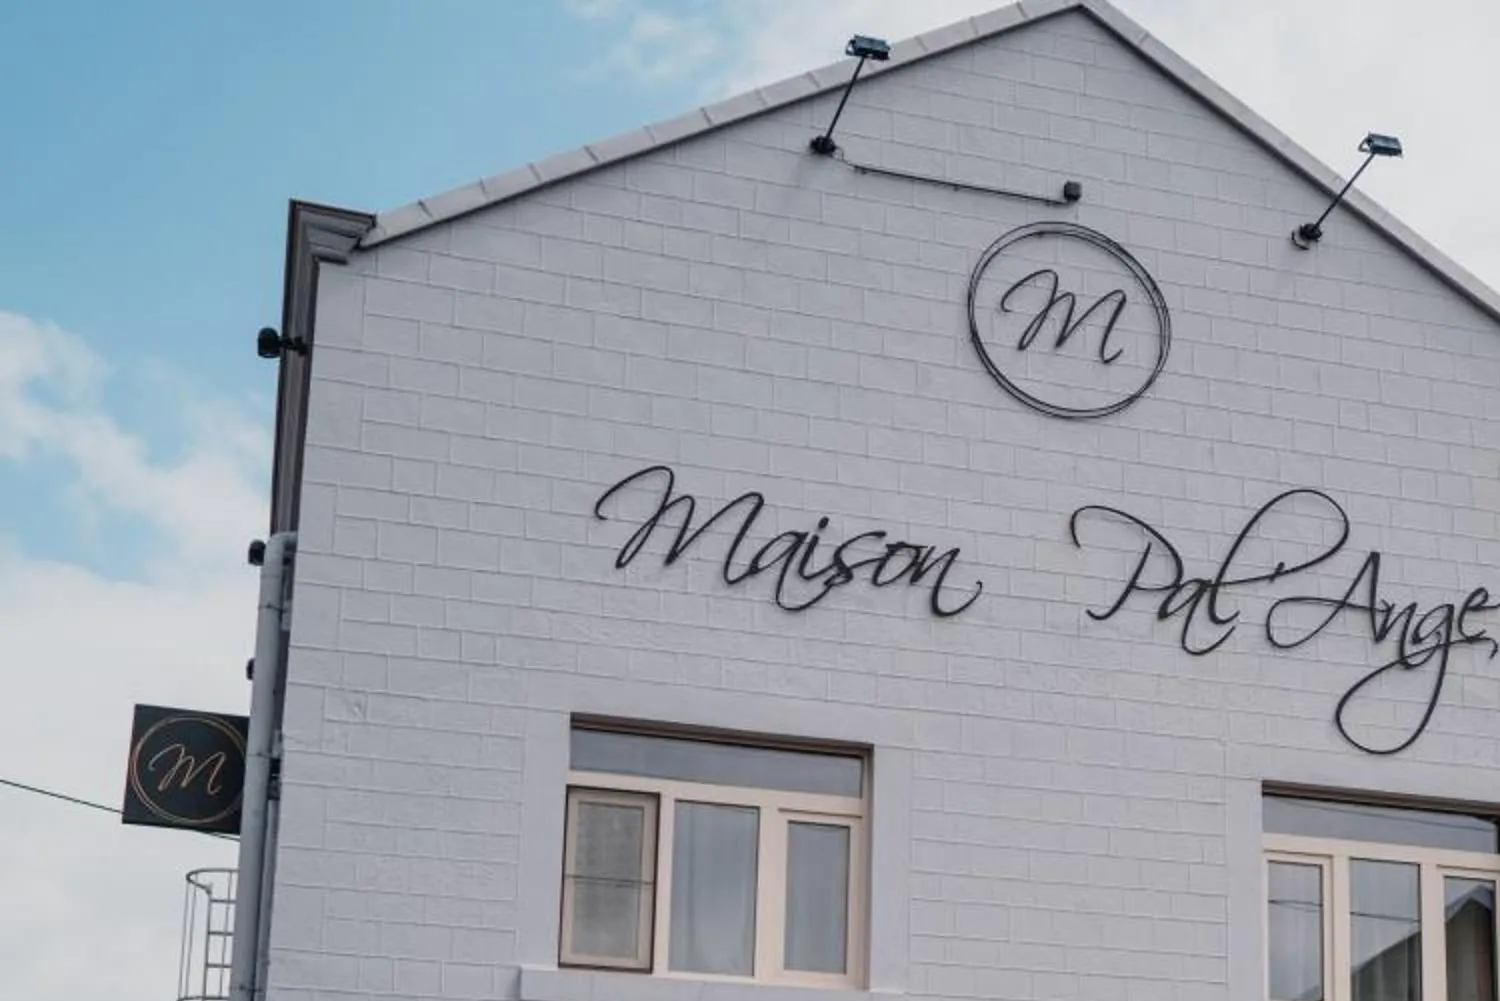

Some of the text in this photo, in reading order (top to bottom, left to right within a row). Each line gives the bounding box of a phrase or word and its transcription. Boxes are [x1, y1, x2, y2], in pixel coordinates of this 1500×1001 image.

[1000, 268, 1128, 365] M
[594, 464, 984, 618] Maison
[147, 742, 228, 796] M
